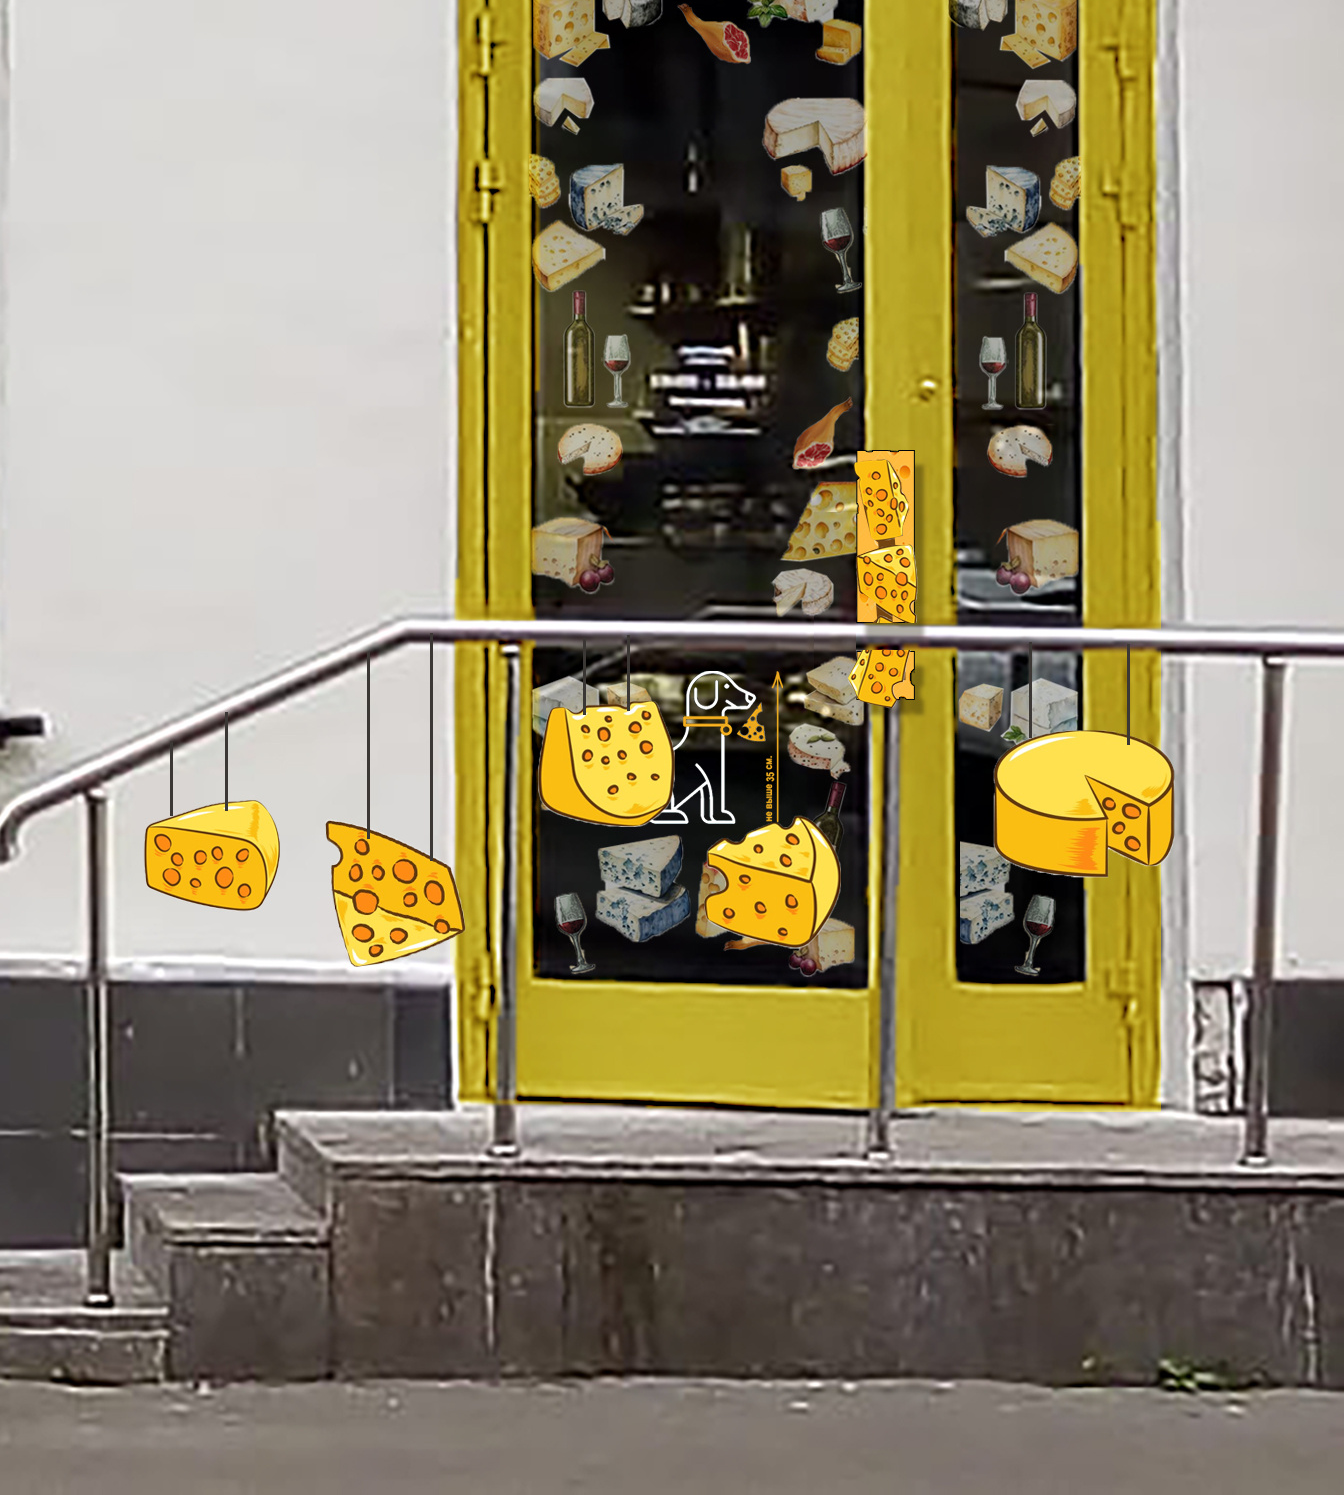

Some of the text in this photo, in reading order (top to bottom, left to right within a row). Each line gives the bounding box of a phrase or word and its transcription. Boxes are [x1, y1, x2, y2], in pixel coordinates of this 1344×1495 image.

[765, 755, 775, 822] не выше 35 см.
